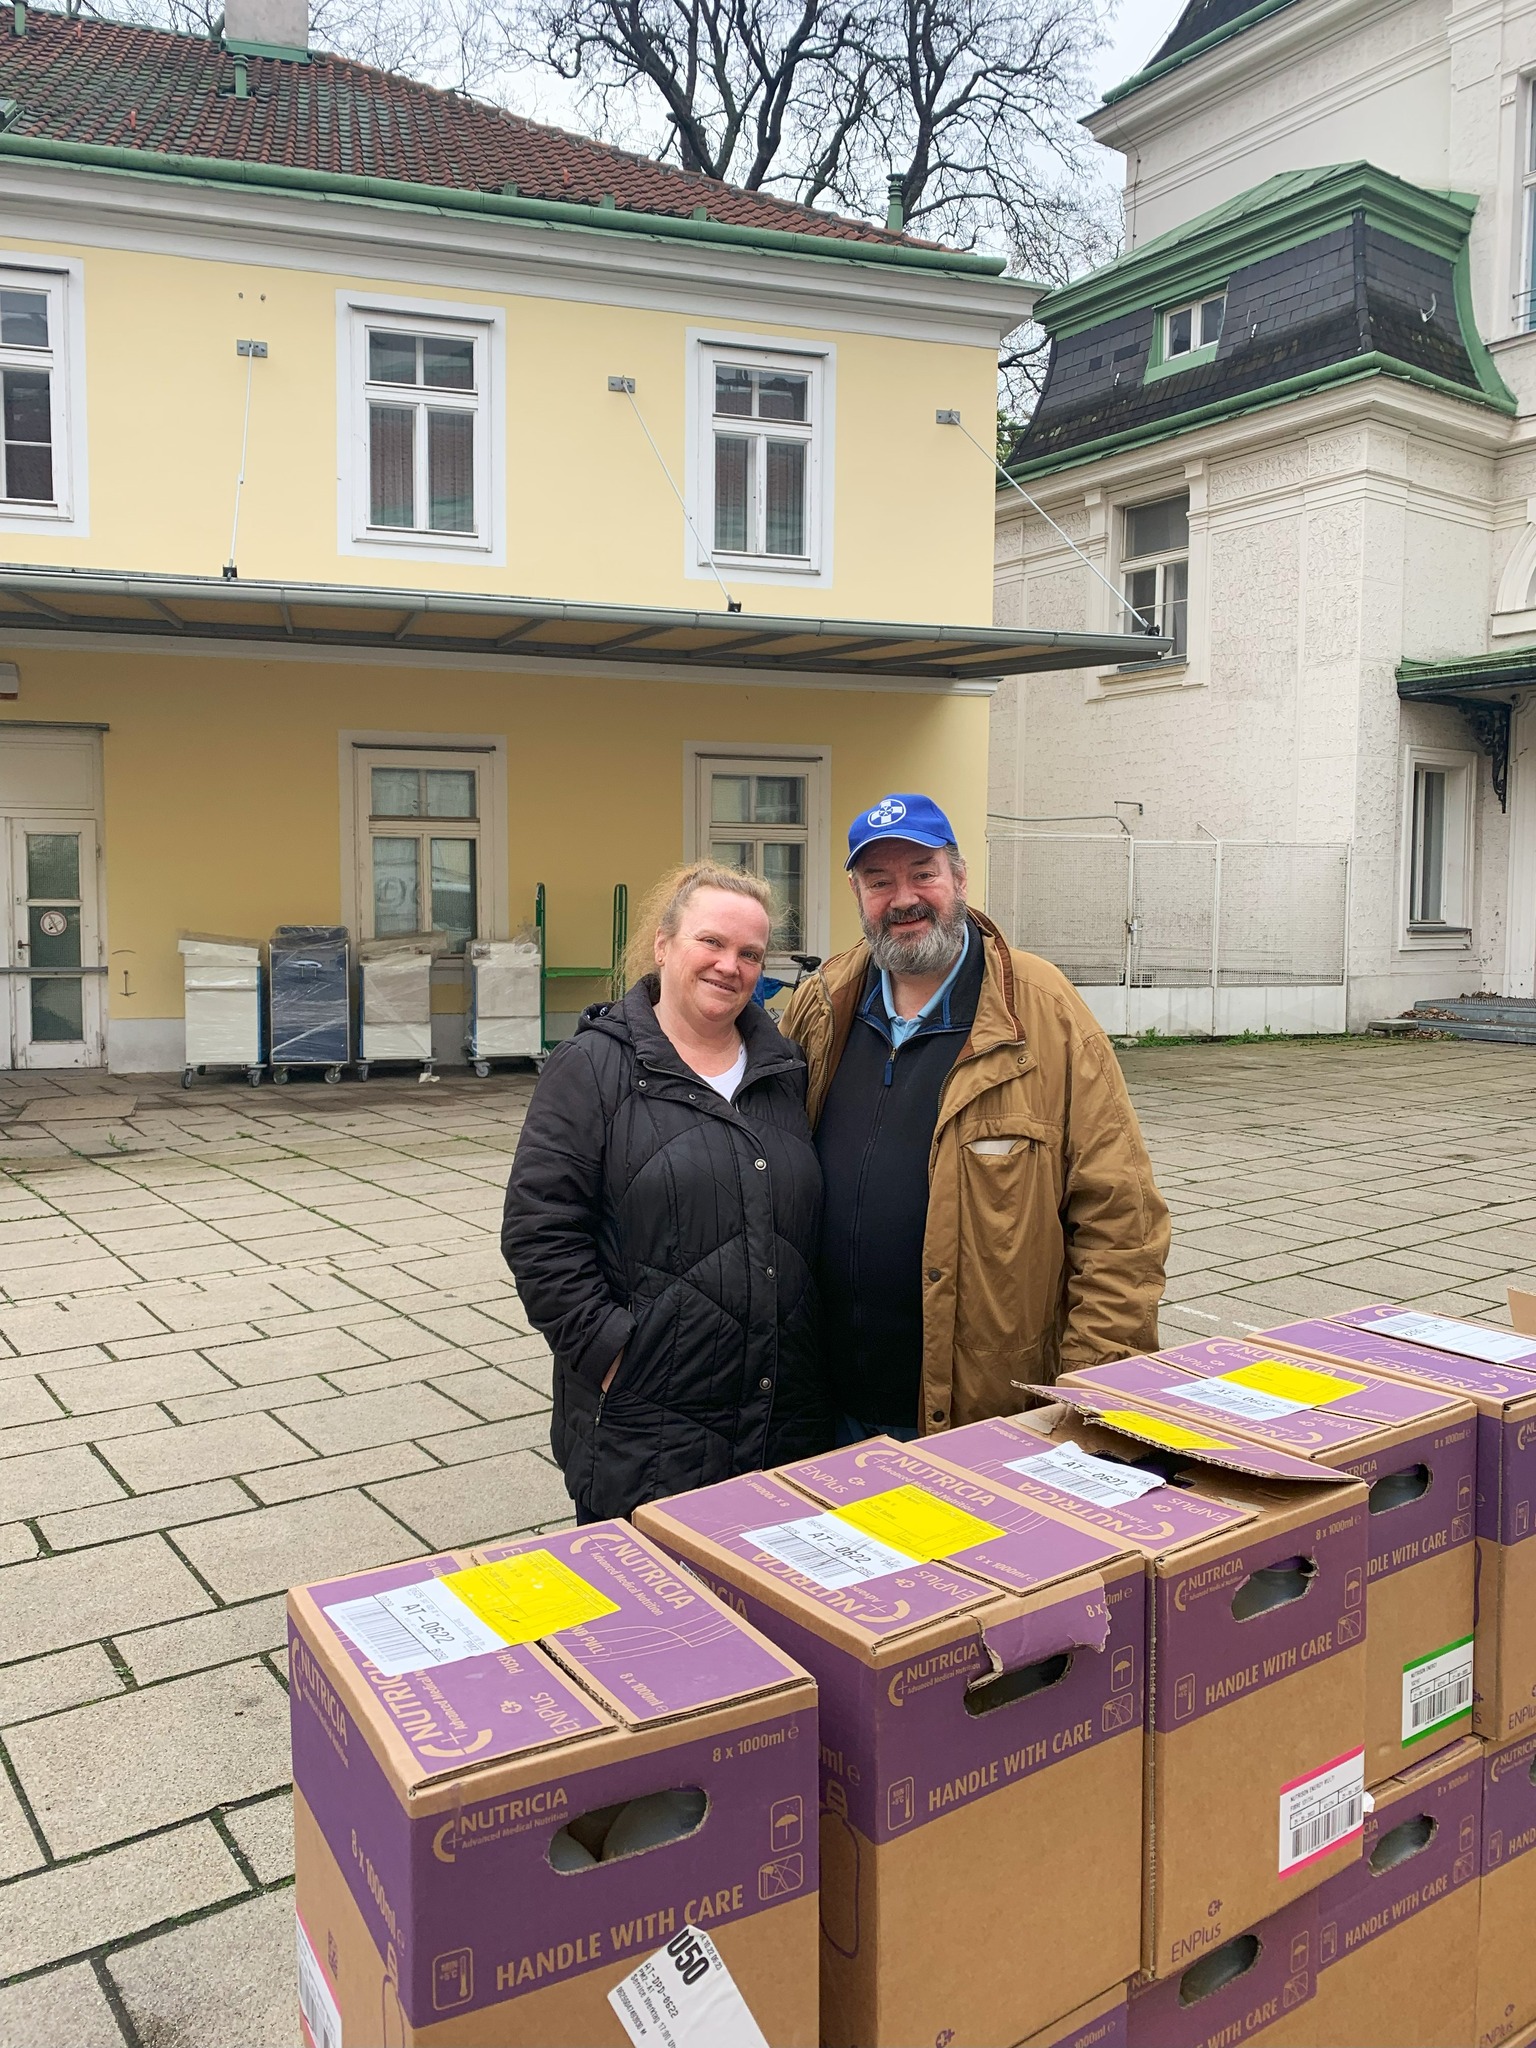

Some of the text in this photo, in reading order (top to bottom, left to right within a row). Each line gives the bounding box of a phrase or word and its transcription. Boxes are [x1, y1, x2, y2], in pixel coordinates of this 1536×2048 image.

[1363, 1357, 1474, 1389] NUTRICIA
[798, 1465, 849, 1495] ENPlus
[877, 1464, 913, 1487] Advanced
[939, 1492, 976, 1513] Nutrition
[892, 1456, 997, 1508] NUTRICIA
[1016, 1481, 1130, 1533] NUTRICIA
[1168, 1497, 1232, 1522] ENPlus
[808, 1531, 872, 1564] AT-0622
[1315, 1529, 1321, 1540] 8
[1322, 1528, 1327, 1538] x
[1328, 1516, 1354, 1536] 1000ml
[1392, 1541, 1419, 1566] WITH
[1422, 1530, 1448, 1553] CARE
[590, 1551, 664, 1617] Advanced Medical Nutrition
[610, 1542, 696, 1610] NUTRICIA
[751, 1552, 867, 1614] NUTRICIA
[914, 1570, 978, 1600] ENPlus
[974, 1554, 983, 1562] 8
[991, 1562, 1026, 1582] 1000ml
[1188, 1557, 1244, 1590] NUTRICIA
[401, 1603, 455, 1644] AT-0622
[1086, 1604, 1095, 1617] 8
[1095, 1604, 1103, 1615] x
[496, 1653, 525, 1676] PUSH
[583, 1638, 605, 1655] PULL
[907, 1643, 979, 1685] NUTRICIA
[907, 1680, 934, 1695] Advanced
[934, 1671, 955, 1689] Medical
[1205, 1663, 1259, 1706] HANDLE
[1263, 1647, 1296, 1677] WITH
[1300, 1632, 1332, 1662] CARE
[301, 1646, 348, 1747] NUTRICIA
[423, 1679, 468, 1730] Advanced Medical
[620, 1672, 628, 1680] 8
[632, 1681, 661, 1708] 1000ml
[530, 1692, 581, 1734] ENPlus
[712, 1747, 721, 1762] 8
[725, 1746, 734, 1759] x
[738, 1731, 786, 1756] 1000ml
[928, 1719, 1092, 1812] HANDLE WITH CARE
[461, 1788, 568, 1835] NUTRICIA
[462, 1811, 569, 1849] Advanced Medical Nutrition
[351, 1829, 358, 1849] 8
[358, 1851, 365, 1867] x
[366, 1857, 396, 1936] 1000ml
[1345, 1873, 1448, 1948] HANDLE WITH CARE
[496, 1884, 744, 1991] HANDLE WITH CARE
[1171, 1922, 1221, 1963] ENPlus
[637, 1969, 655, 1994] PM2-AT
[644, 1962, 679, 2018] AT-DPD-0622
[630, 1974, 647, 1999] Service
[644, 1996, 661, 2024] Werktag
[657, 2022, 671, 2041] 17:00
[1207, 1998, 1277, 2048] WITH CARE
